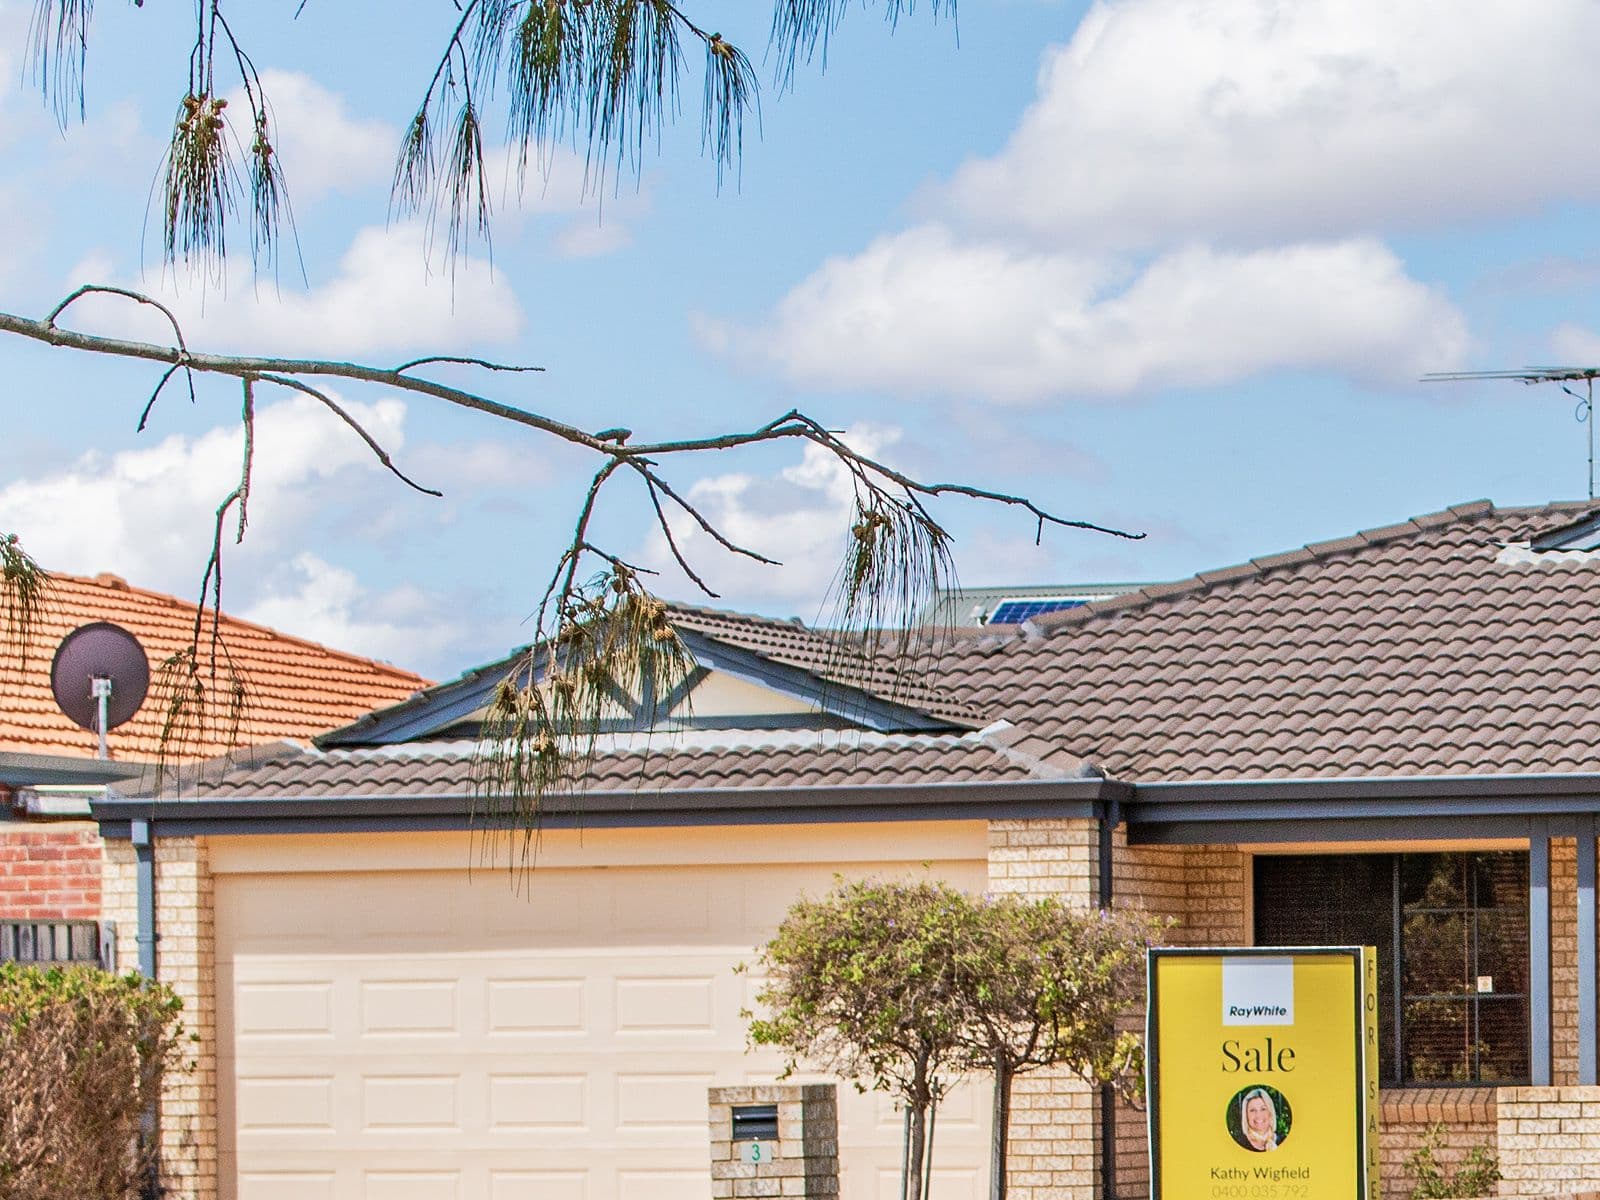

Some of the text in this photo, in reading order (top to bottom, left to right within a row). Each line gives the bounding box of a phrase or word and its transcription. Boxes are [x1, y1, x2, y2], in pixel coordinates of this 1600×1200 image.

[1222, 1036, 1296, 1073] Sale
[1366, 959, 1377, 1200] FOR SALE
[751, 1143, 761, 1161] 3
[1210, 1166, 1311, 1182] Kathy Wigfield
[1211, 1184, 1309, 1199] 0400 035 792
